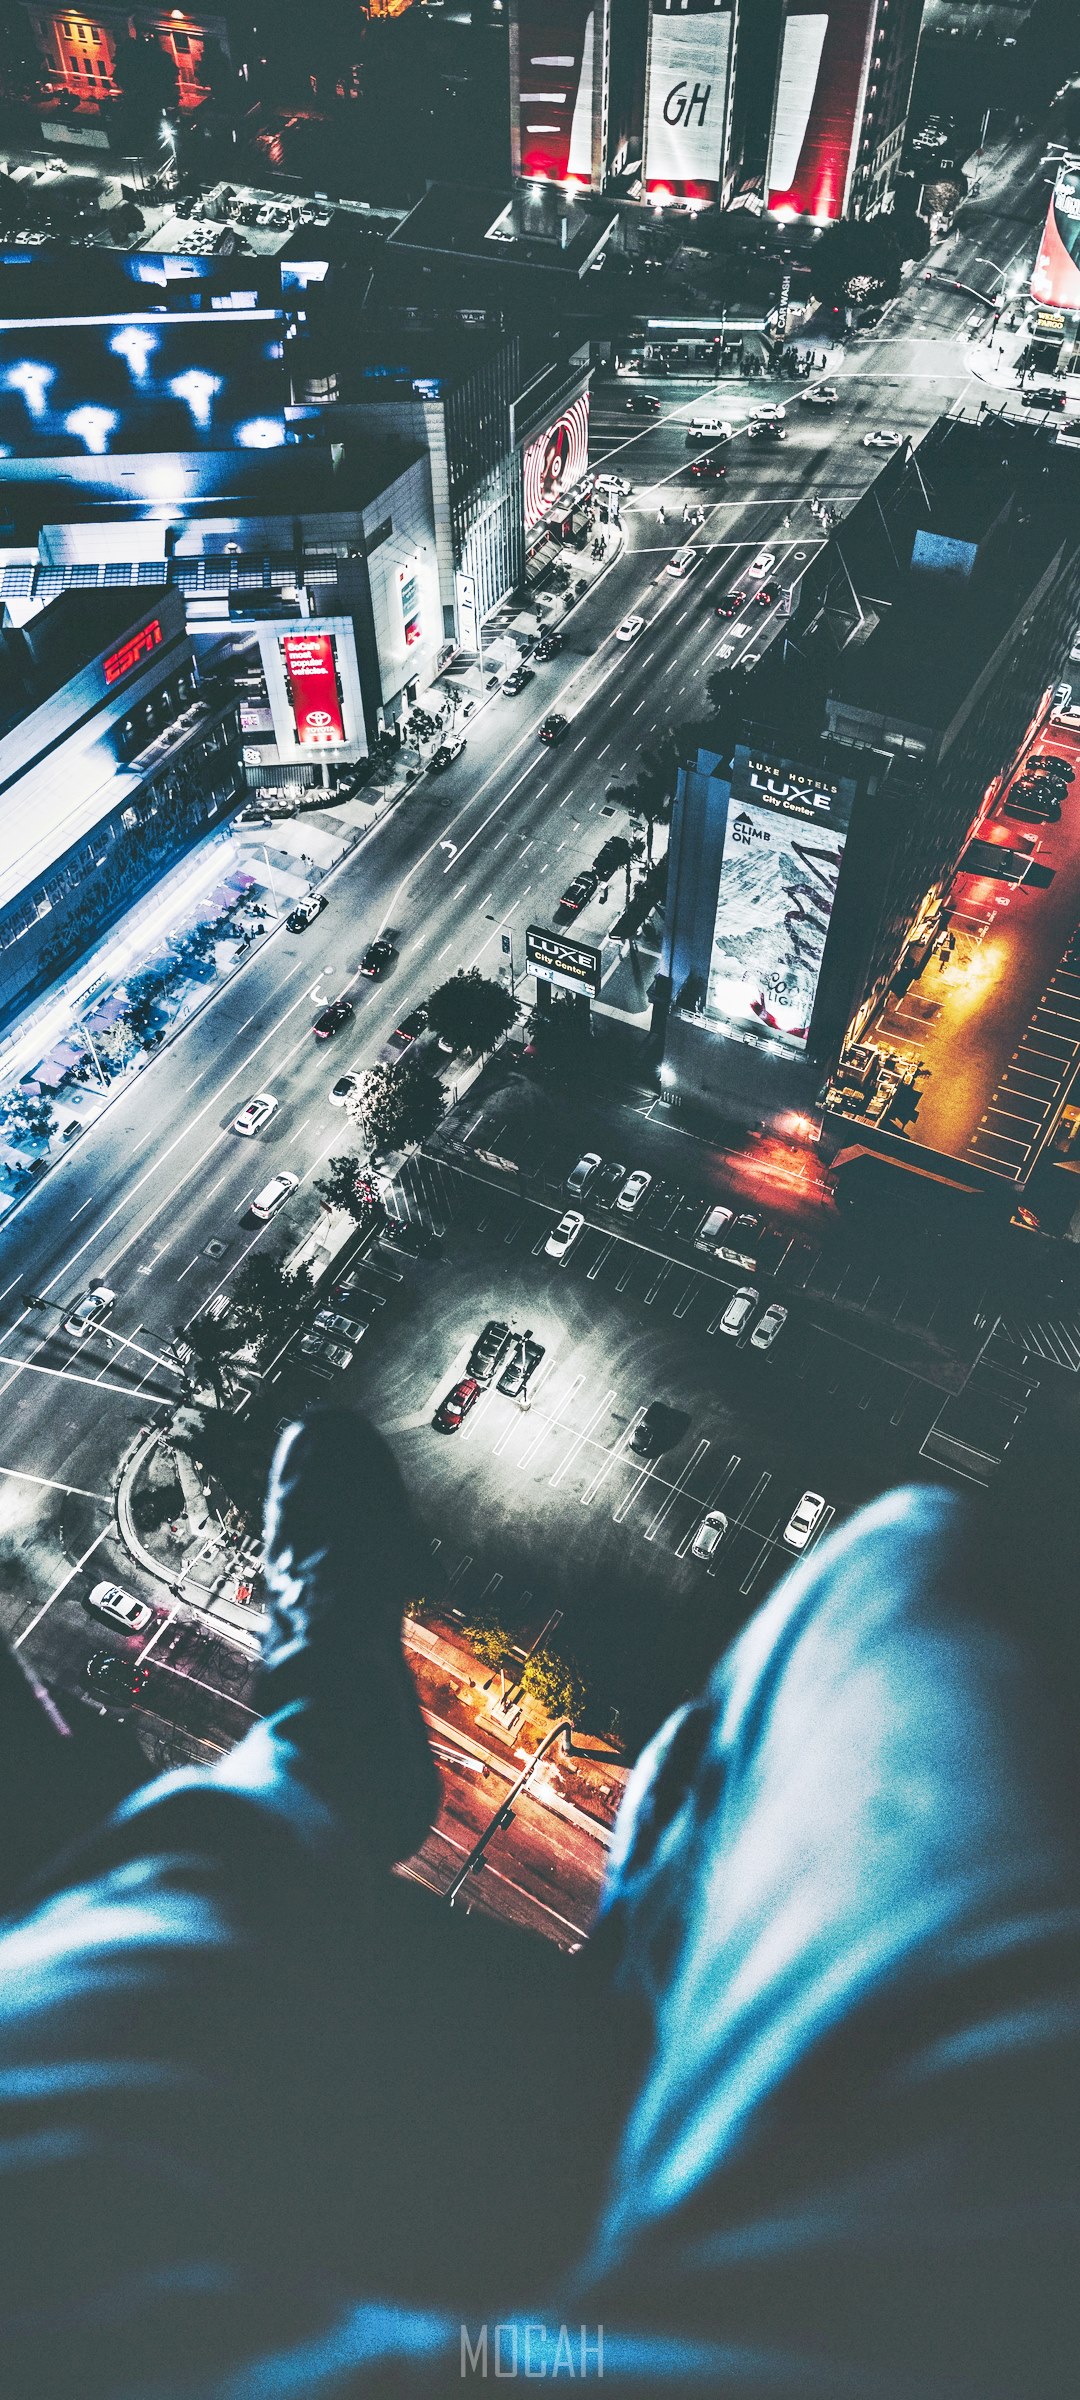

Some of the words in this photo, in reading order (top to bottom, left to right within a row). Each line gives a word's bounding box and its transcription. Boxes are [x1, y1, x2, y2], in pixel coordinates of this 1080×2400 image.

[663, 81, 711, 127] GH
[780, 275, 791, 307] WASH
[777, 307, 787, 329] CAR
[1038, 319, 1063, 329] FARGO
[103, 619, 163, 685] ESPN
[289, 651, 312, 659] most
[715, 643, 735, 659] BUS
[290, 658, 323, 668] popular
[306, 726, 336, 734] TOYOTA
[748, 760, 780, 776] LUXE
[789, 773, 838, 794] HOTELS
[750, 773, 832, 811] LUXE
[762, 794, 781, 807] City
[782, 801, 815, 817] Center
[732, 832, 751, 846] ON
[733, 823, 771, 841] CLIMB
[529, 936, 593, 968] LUXE
[534, 951, 553, 965] City
[554, 959, 587, 976] Center
